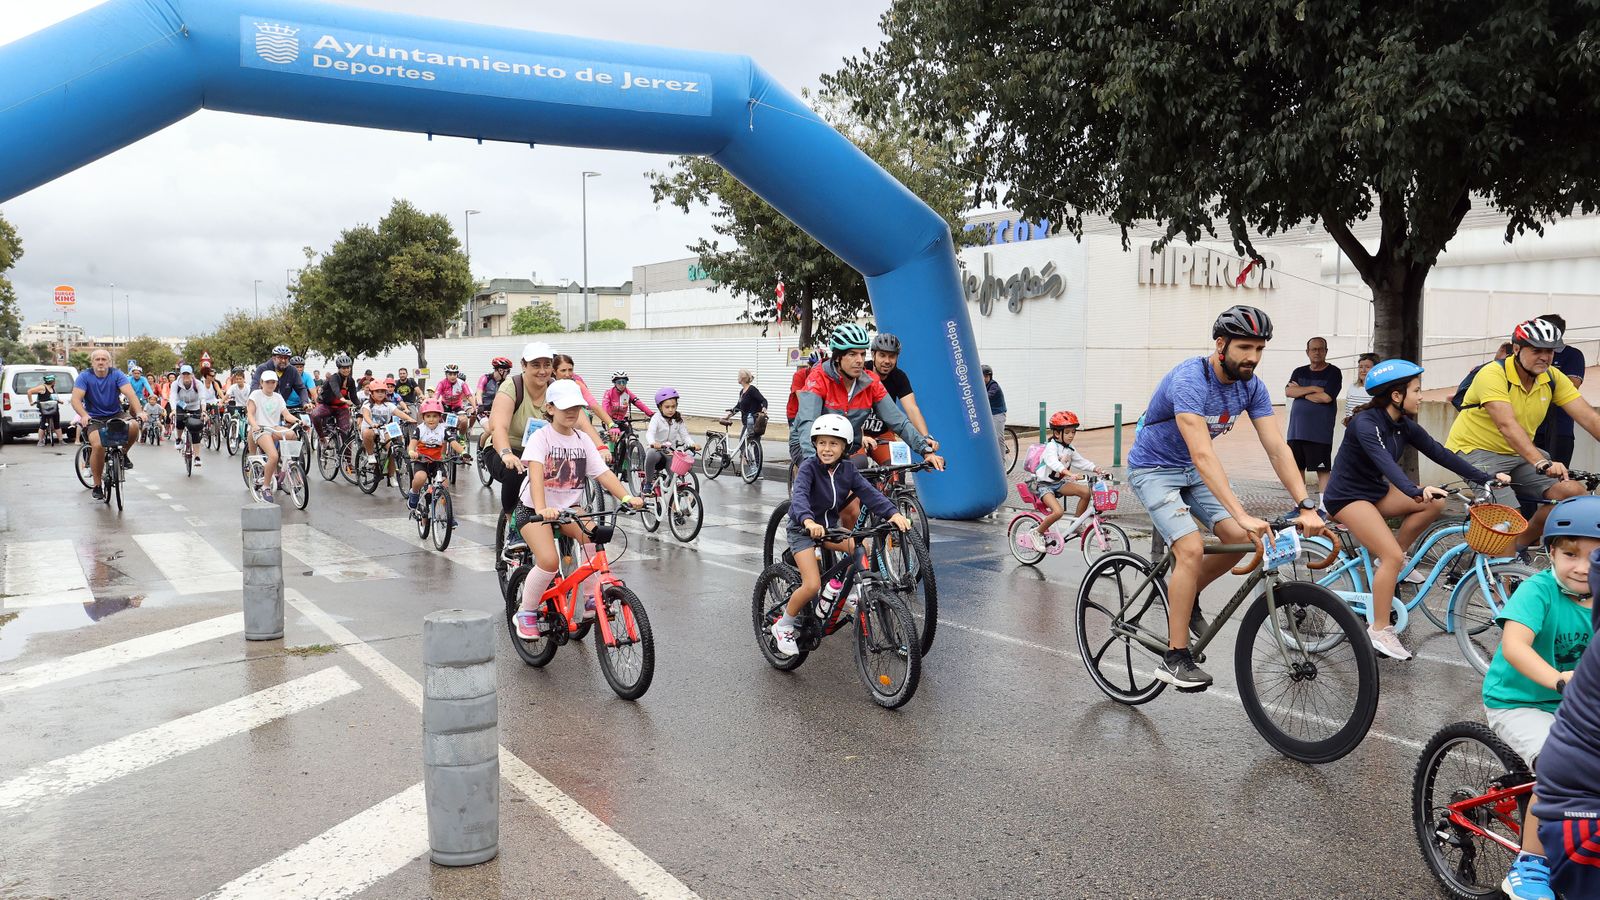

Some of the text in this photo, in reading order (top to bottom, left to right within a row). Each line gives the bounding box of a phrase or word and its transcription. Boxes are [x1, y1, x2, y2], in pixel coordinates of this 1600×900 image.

[313, 34, 699, 92] Ayuntamiento de Jerez
[313, 54, 436, 81] Deportes
[1138, 245, 1280, 289] HIPERCOR
[947, 320, 981, 434] deportes@aytojerez.es
[1554, 631, 1589, 645] WILDR
